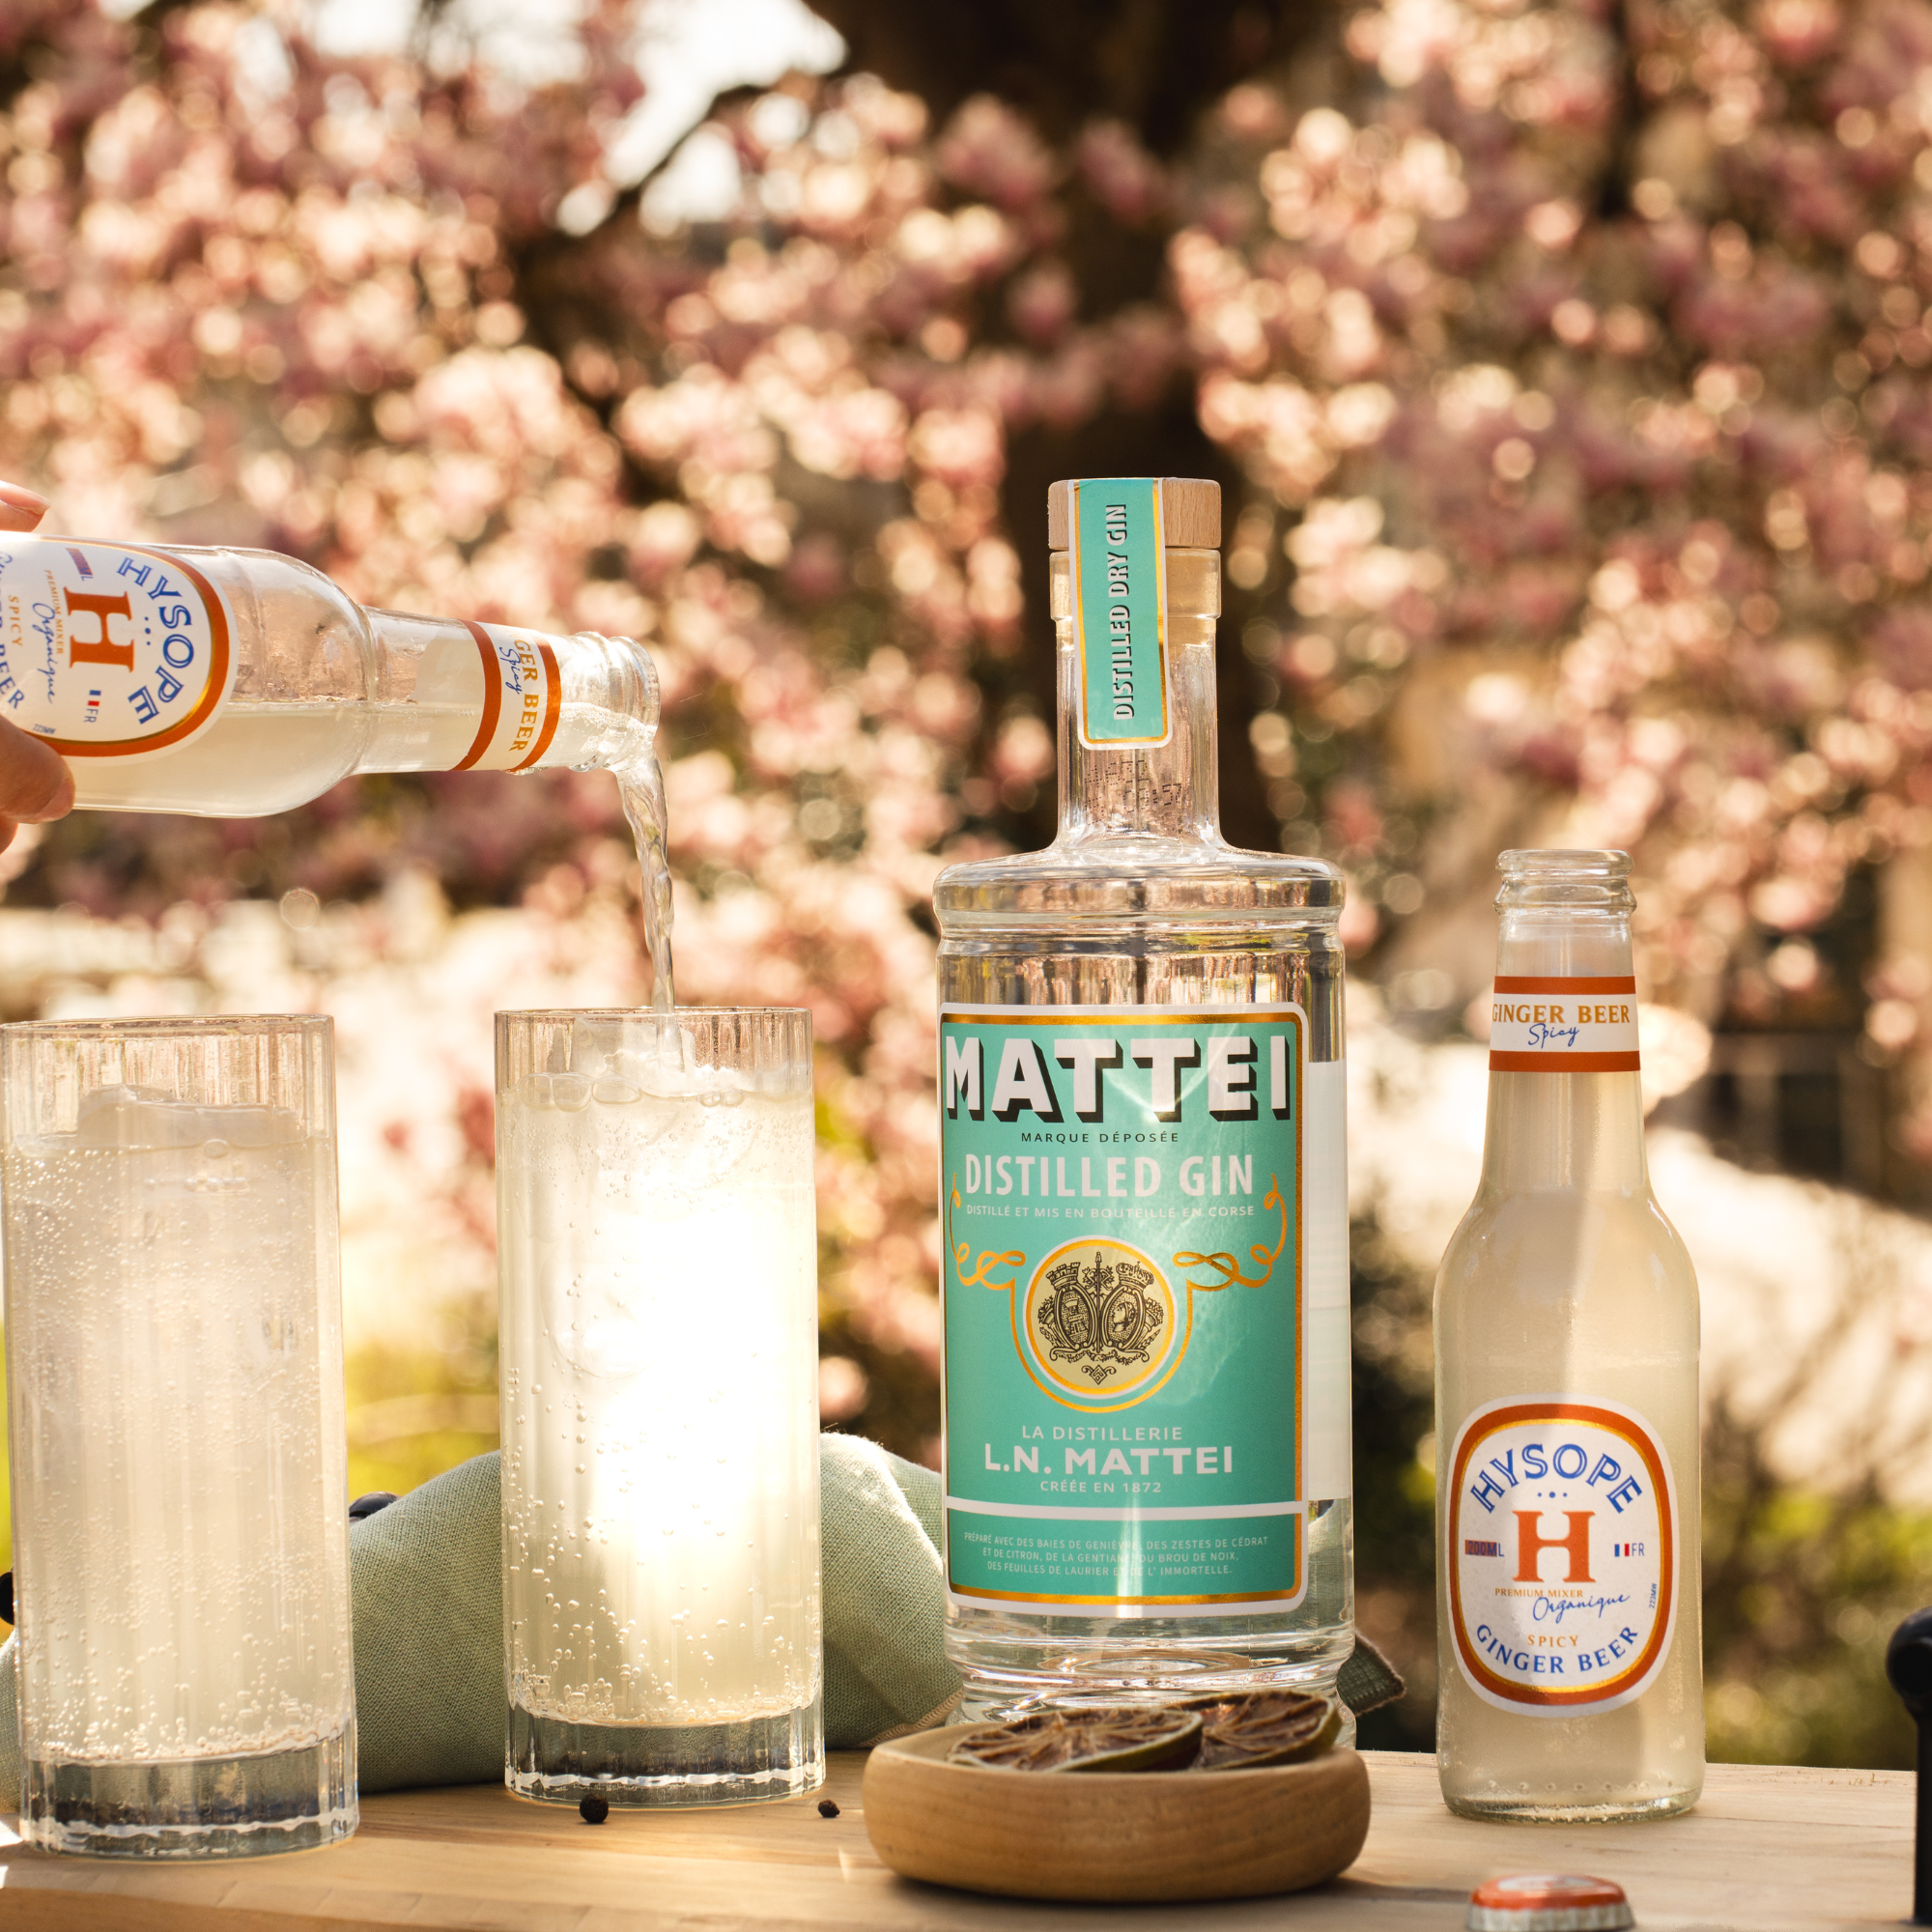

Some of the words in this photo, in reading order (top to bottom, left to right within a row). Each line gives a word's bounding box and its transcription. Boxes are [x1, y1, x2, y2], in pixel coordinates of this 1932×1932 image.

[1105, 504, 1126, 546] GIN
[1107, 552, 1129, 598] DRY
[8, 595, 23, 647] SPICY
[43, 570, 62, 614] PREMIUM
[55, 619, 64, 654] MIXER
[63, 586, 134, 673] H
[117, 557, 194, 724] HYSOPE
[32, 602, 58, 704] Organique
[1109, 604, 1134, 720] DISTILLED
[498, 646, 523, 695] Spicy
[83, 708, 98, 723] FR
[508, 694, 539, 752] BEER
[1492, 1004, 1565, 1023] GINGER
[1577, 1005, 1630, 1023] BEER
[1528, 1023, 1580, 1049] Spicy
[946, 1035, 1291, 1123] MATTEI
[1021, 1133, 1089, 1144] MARQUE
[1099, 1130, 1179, 1143] DÉPOSÉE
[966, 1153, 1160, 1197] DISTILLED
[1179, 1154, 1253, 1197] GIN
[966, 1204, 1010, 1216] DISTILLÉ
[1015, 1208, 1029, 1216] ET
[1035, 1208, 1060, 1218] MIS
[1065, 1208, 1084, 1218] EN
[1091, 1208, 1176, 1219] BOUTEILLE
[1182, 1208, 1203, 1218] EN
[1208, 1206, 1254, 1217] CORSE
[1022, 1425, 1044, 1439] LA
[1052, 1427, 1182, 1441] DISTILLERIE
[984, 1443, 1052, 1475] L.N.
[1065, 1446, 1233, 1475] MATTEI
[1040, 1478, 1087, 1492] CRÉÉE
[1094, 1482, 1115, 1493] EN
[1122, 1482, 1162, 1493] 1872
[1470, 1443, 1643, 1514] HYSOPE
[964, 1531, 992, 1544] PRÉPARÉ
[994, 1536, 1013, 1546] AVEC
[1016, 1538, 1034, 1548] DES
[1037, 1539, 1065, 1548] BAIES
[1068, 1540, 1081, 1549] DE
[1147, 1541, 1168, 1549] DES
[1171, 1540, 1211, 1549] ZESTES
[1215, 1539, 1228, 1548] DE
[1231, 1536, 1268, 1547] CÉDRAT
[982, 1548, 991, 1556] ET
[994, 1548, 1004, 1558] DE
[1007, 1549, 1043, 1562] CITRON,
[1046, 1552, 1058, 1561] DE
[1063, 1553, 1074, 1562] LA
[1140, 1554, 1154, 1563] DU
[1159, 1553, 1189, 1563] BROU
[1193, 1552, 1207, 1562] DE
[1210, 1551, 1239, 1562] NOIX,
[1467, 1540, 1504, 1557] 200ML
[1511, 1510, 1597, 1583] H
[1632, 1543, 1645, 1557] FR
[987, 1561, 1002, 1571] DES
[1005, 1563, 1045, 1575] FEUILLES
[1049, 1566, 1061, 1575] DE
[1065, 1567, 1109, 1576] LAURIER
[1160, 1565, 1233, 1576] IMMORTELLE.
[1494, 1587, 1543, 1598] PREMIUM
[1548, 1589, 1583, 1598] MIXER
[1533, 1595, 1631, 1624] Organique
[1477, 1624, 1564, 1674] GINGER
[1577, 1627, 1638, 1672] BEER
[1527, 1634, 1579, 1648] SPICY
